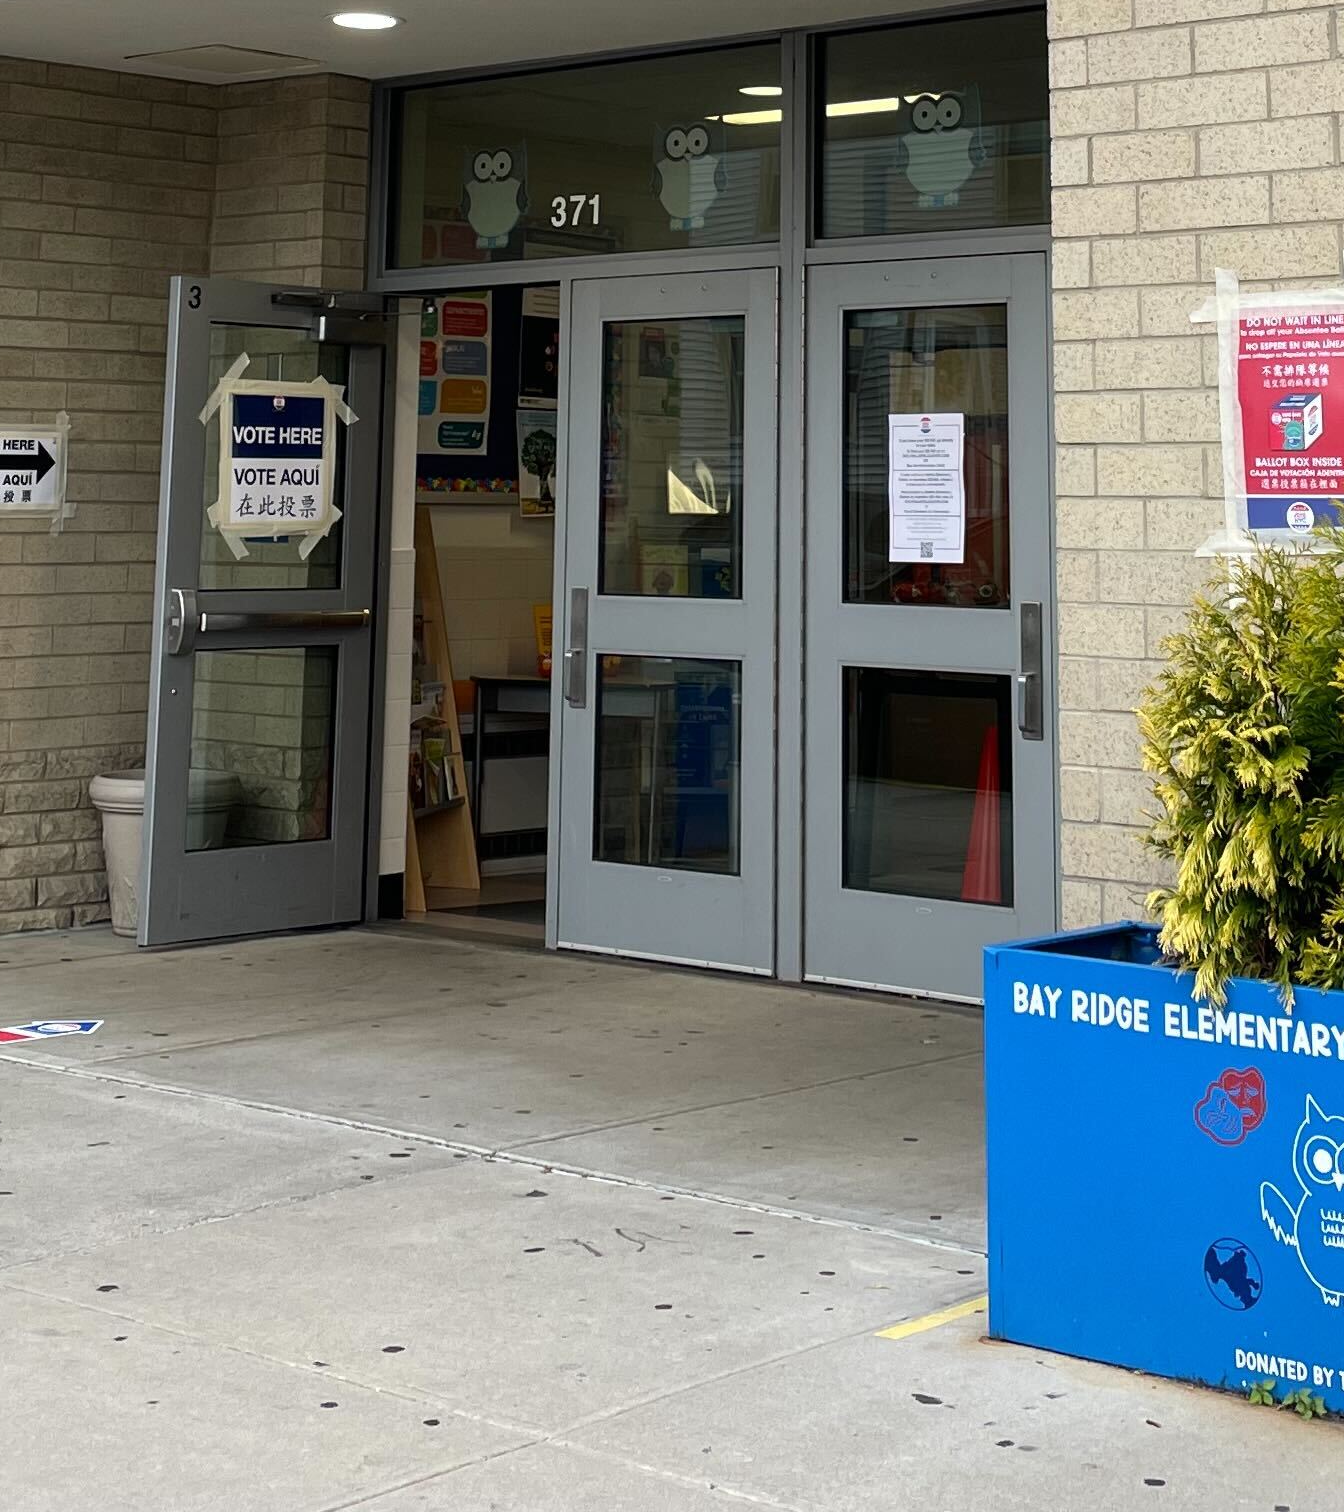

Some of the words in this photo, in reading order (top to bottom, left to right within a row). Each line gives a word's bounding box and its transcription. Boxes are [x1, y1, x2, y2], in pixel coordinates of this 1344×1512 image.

[551, 194, 599, 227] 371
[188, 285, 202, 310] 3
[1246, 317, 1261, 327] DO
[1263, 316, 1282, 327] NOT
[1285, 315, 1308, 326] WAIT
[1311, 314, 1321, 325] IN
[1324, 314, 1344, 325] LINE
[1245, 342, 1259, 351] NO
[1260, 341, 1287, 351] ESPERE
[1289, 340, 1300, 350] EN
[1302, 340, 1321, 349] UNA
[3, 439, 35, 450] HERE
[233, 426, 275, 444] VOTE
[279, 427, 322, 445] HERE
[1255, 457, 1288, 467] BALLOT
[1289, 457, 1309, 467] BOX
[1312, 457, 1343, 467] INSIDE
[2, 472, 33, 486] AQUÍ
[234, 468, 276, 485] VOTE
[280, 464, 320, 486] AQUÍ
[1249, 469, 1268, 477] CAJA
[1269, 469, 1279, 477] DE
[236, 493, 316, 519] 在此投票
[1013, 981, 1062, 1019] BAY
[1071, 989, 1150, 1033] RIDGE
[1235, 1348, 1308, 1382] DONATED
[1313, 1365, 1335, 1388] BY
